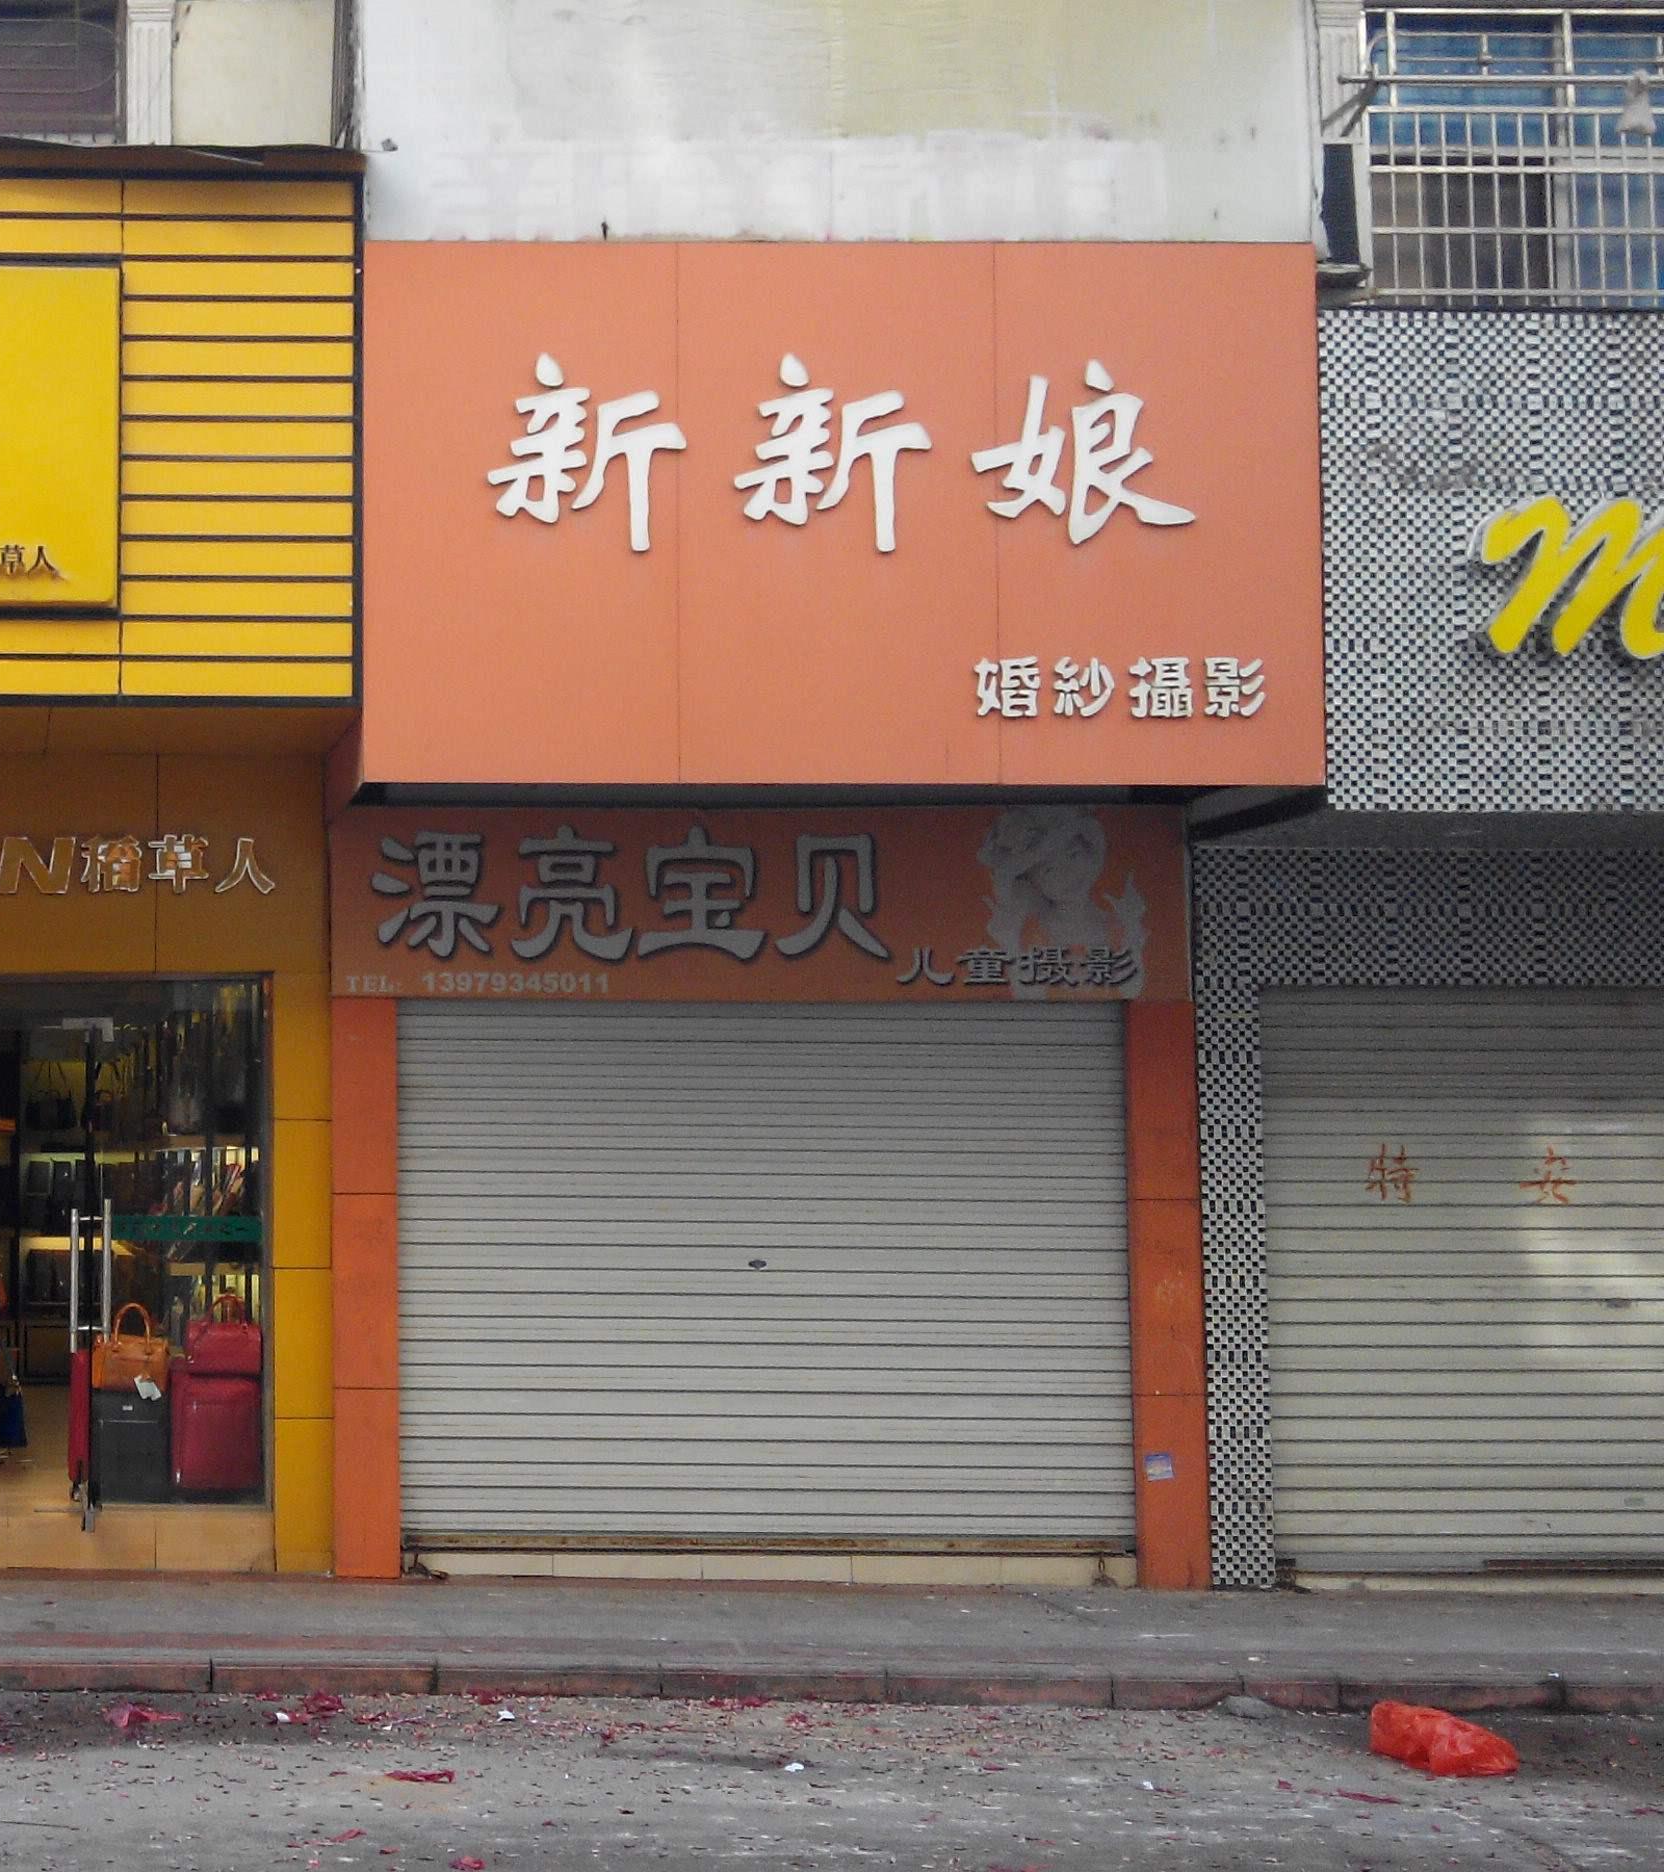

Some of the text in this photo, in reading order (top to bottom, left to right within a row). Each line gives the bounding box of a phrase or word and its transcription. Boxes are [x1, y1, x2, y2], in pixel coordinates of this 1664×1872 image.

[487, 352, 1197, 552] 新新娘
[974, 655, 1267, 719] 婚紗攝影
[80, 834, 275, 893] 稻草人
[371, 825, 889, 962] 漂亮宝贝
[421, 972, 609, 994] 13979345011
[897, 946, 1137, 986] 儿童摄影
